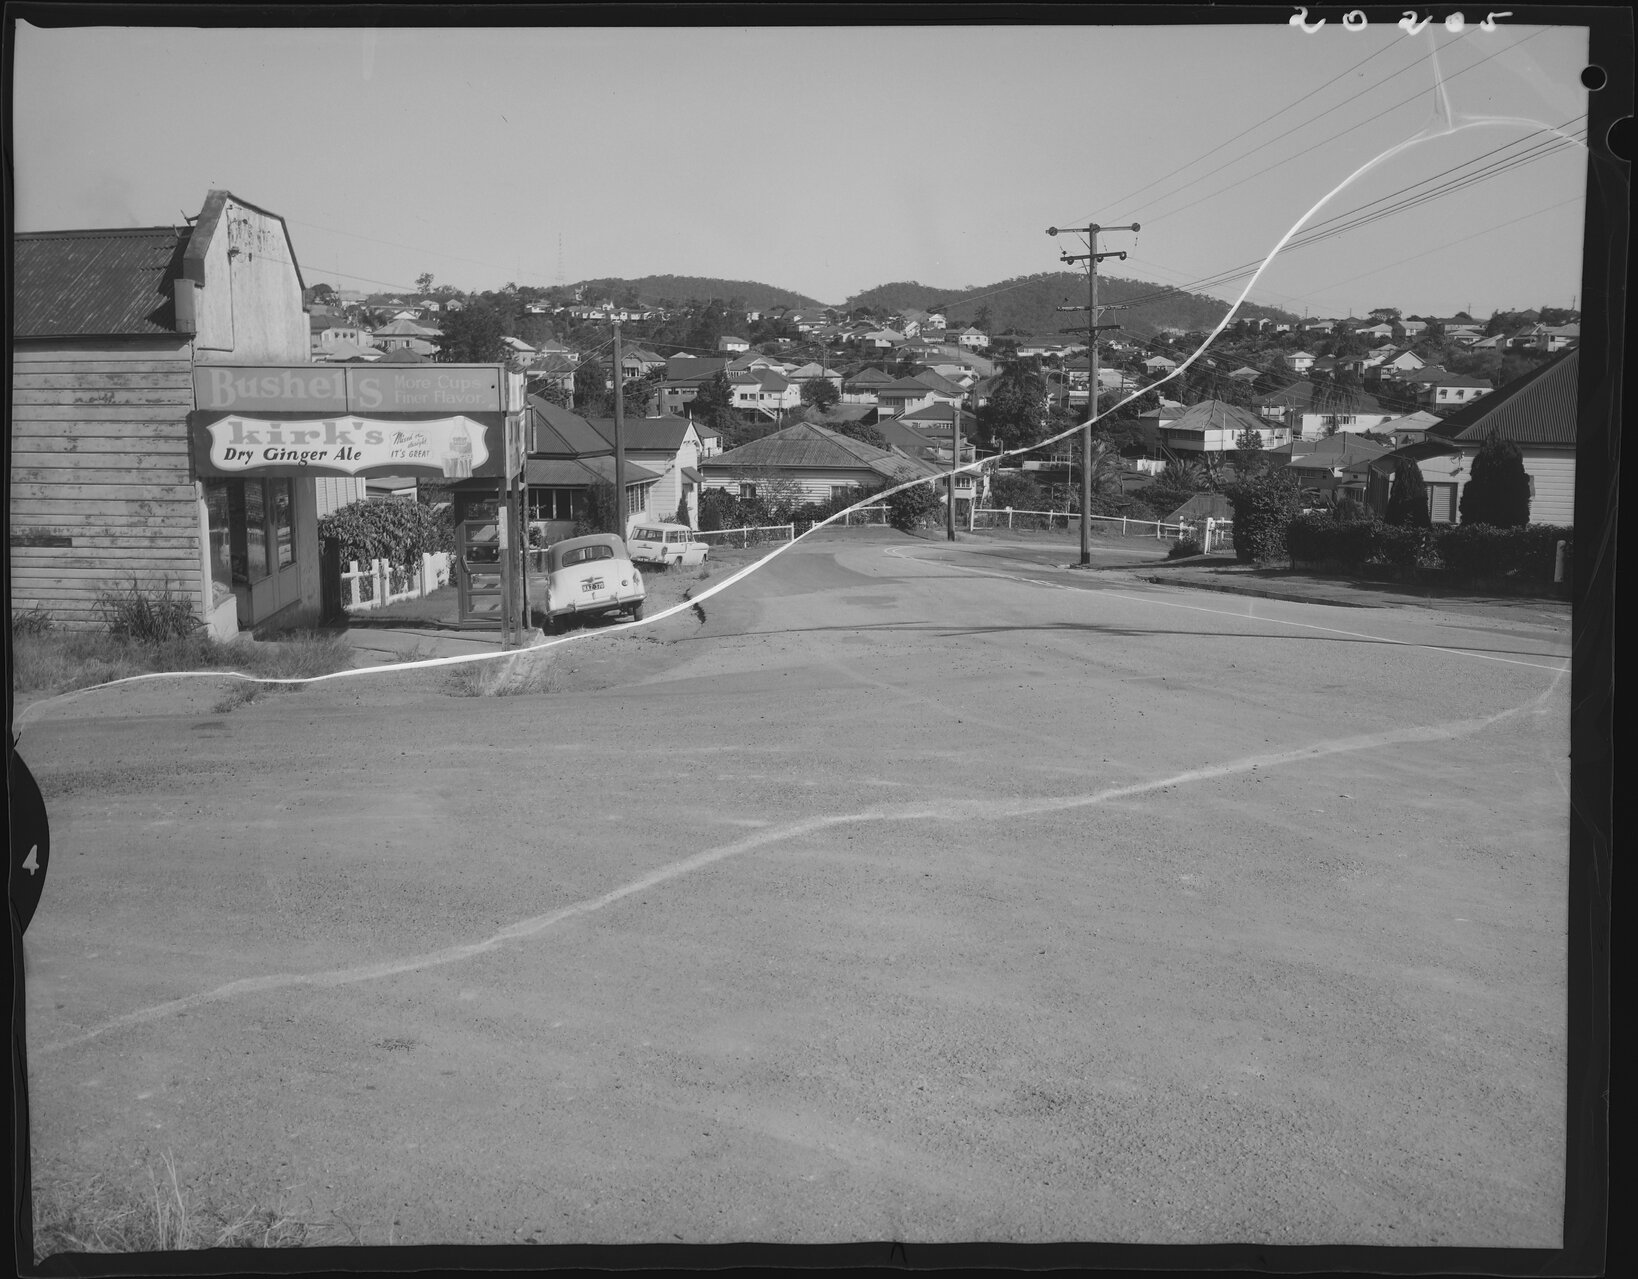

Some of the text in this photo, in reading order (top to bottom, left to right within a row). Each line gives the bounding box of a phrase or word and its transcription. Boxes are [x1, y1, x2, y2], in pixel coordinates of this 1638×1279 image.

[209, 368, 383, 408] Bushells
[395, 374, 481, 392] More Cups
[395, 390, 428, 404] Finer
[228, 421, 384, 445] kirk's
[224, 446, 362, 468] Dry Ginger Ale
[390, 448, 406, 458] IT'S
[22, 844, 39, 875] 4
